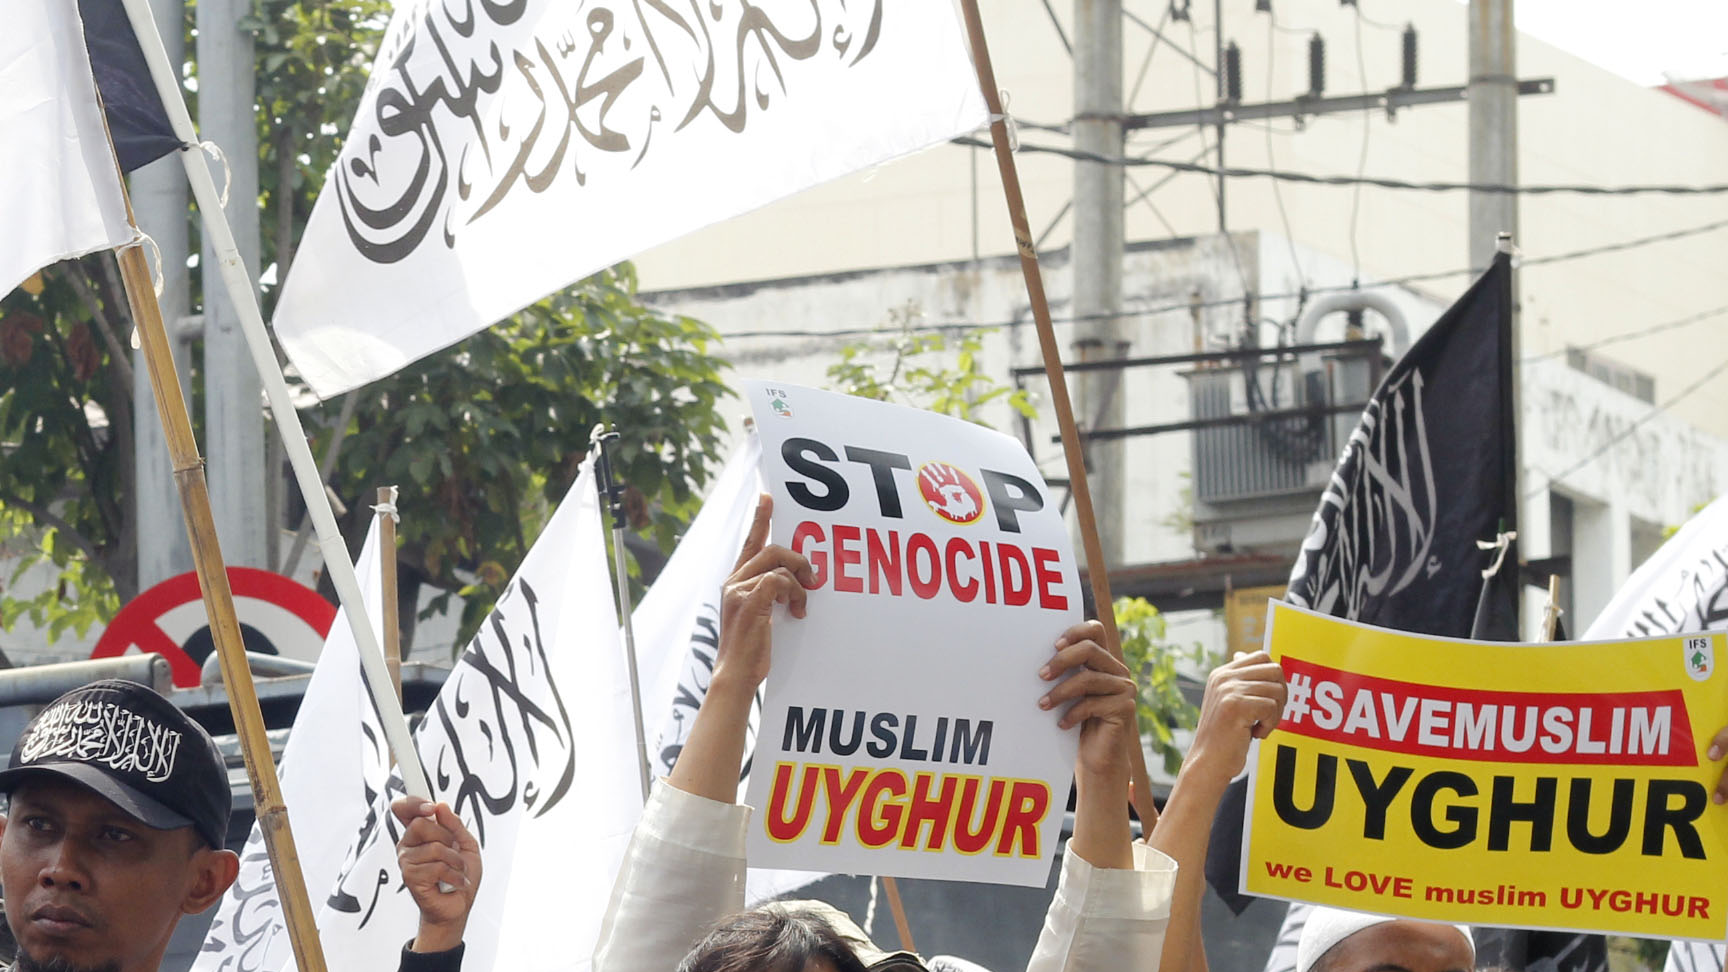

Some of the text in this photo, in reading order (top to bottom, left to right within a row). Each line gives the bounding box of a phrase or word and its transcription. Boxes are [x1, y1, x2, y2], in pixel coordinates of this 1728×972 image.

[766, 387, 788, 399] IFS
[791, 520, 1069, 611] GENOCIDE
[1688, 638, 1708, 650] IFS
[781, 705, 994, 766] MUSLIM
[1281, 672, 1673, 756] #SAVEMUSLIM
[764, 760, 1052, 860] UYGHUR
[1273, 744, 1708, 860] UYGHUR
[1264, 861, 1710, 919] we LOVE muslim UYGHUR
